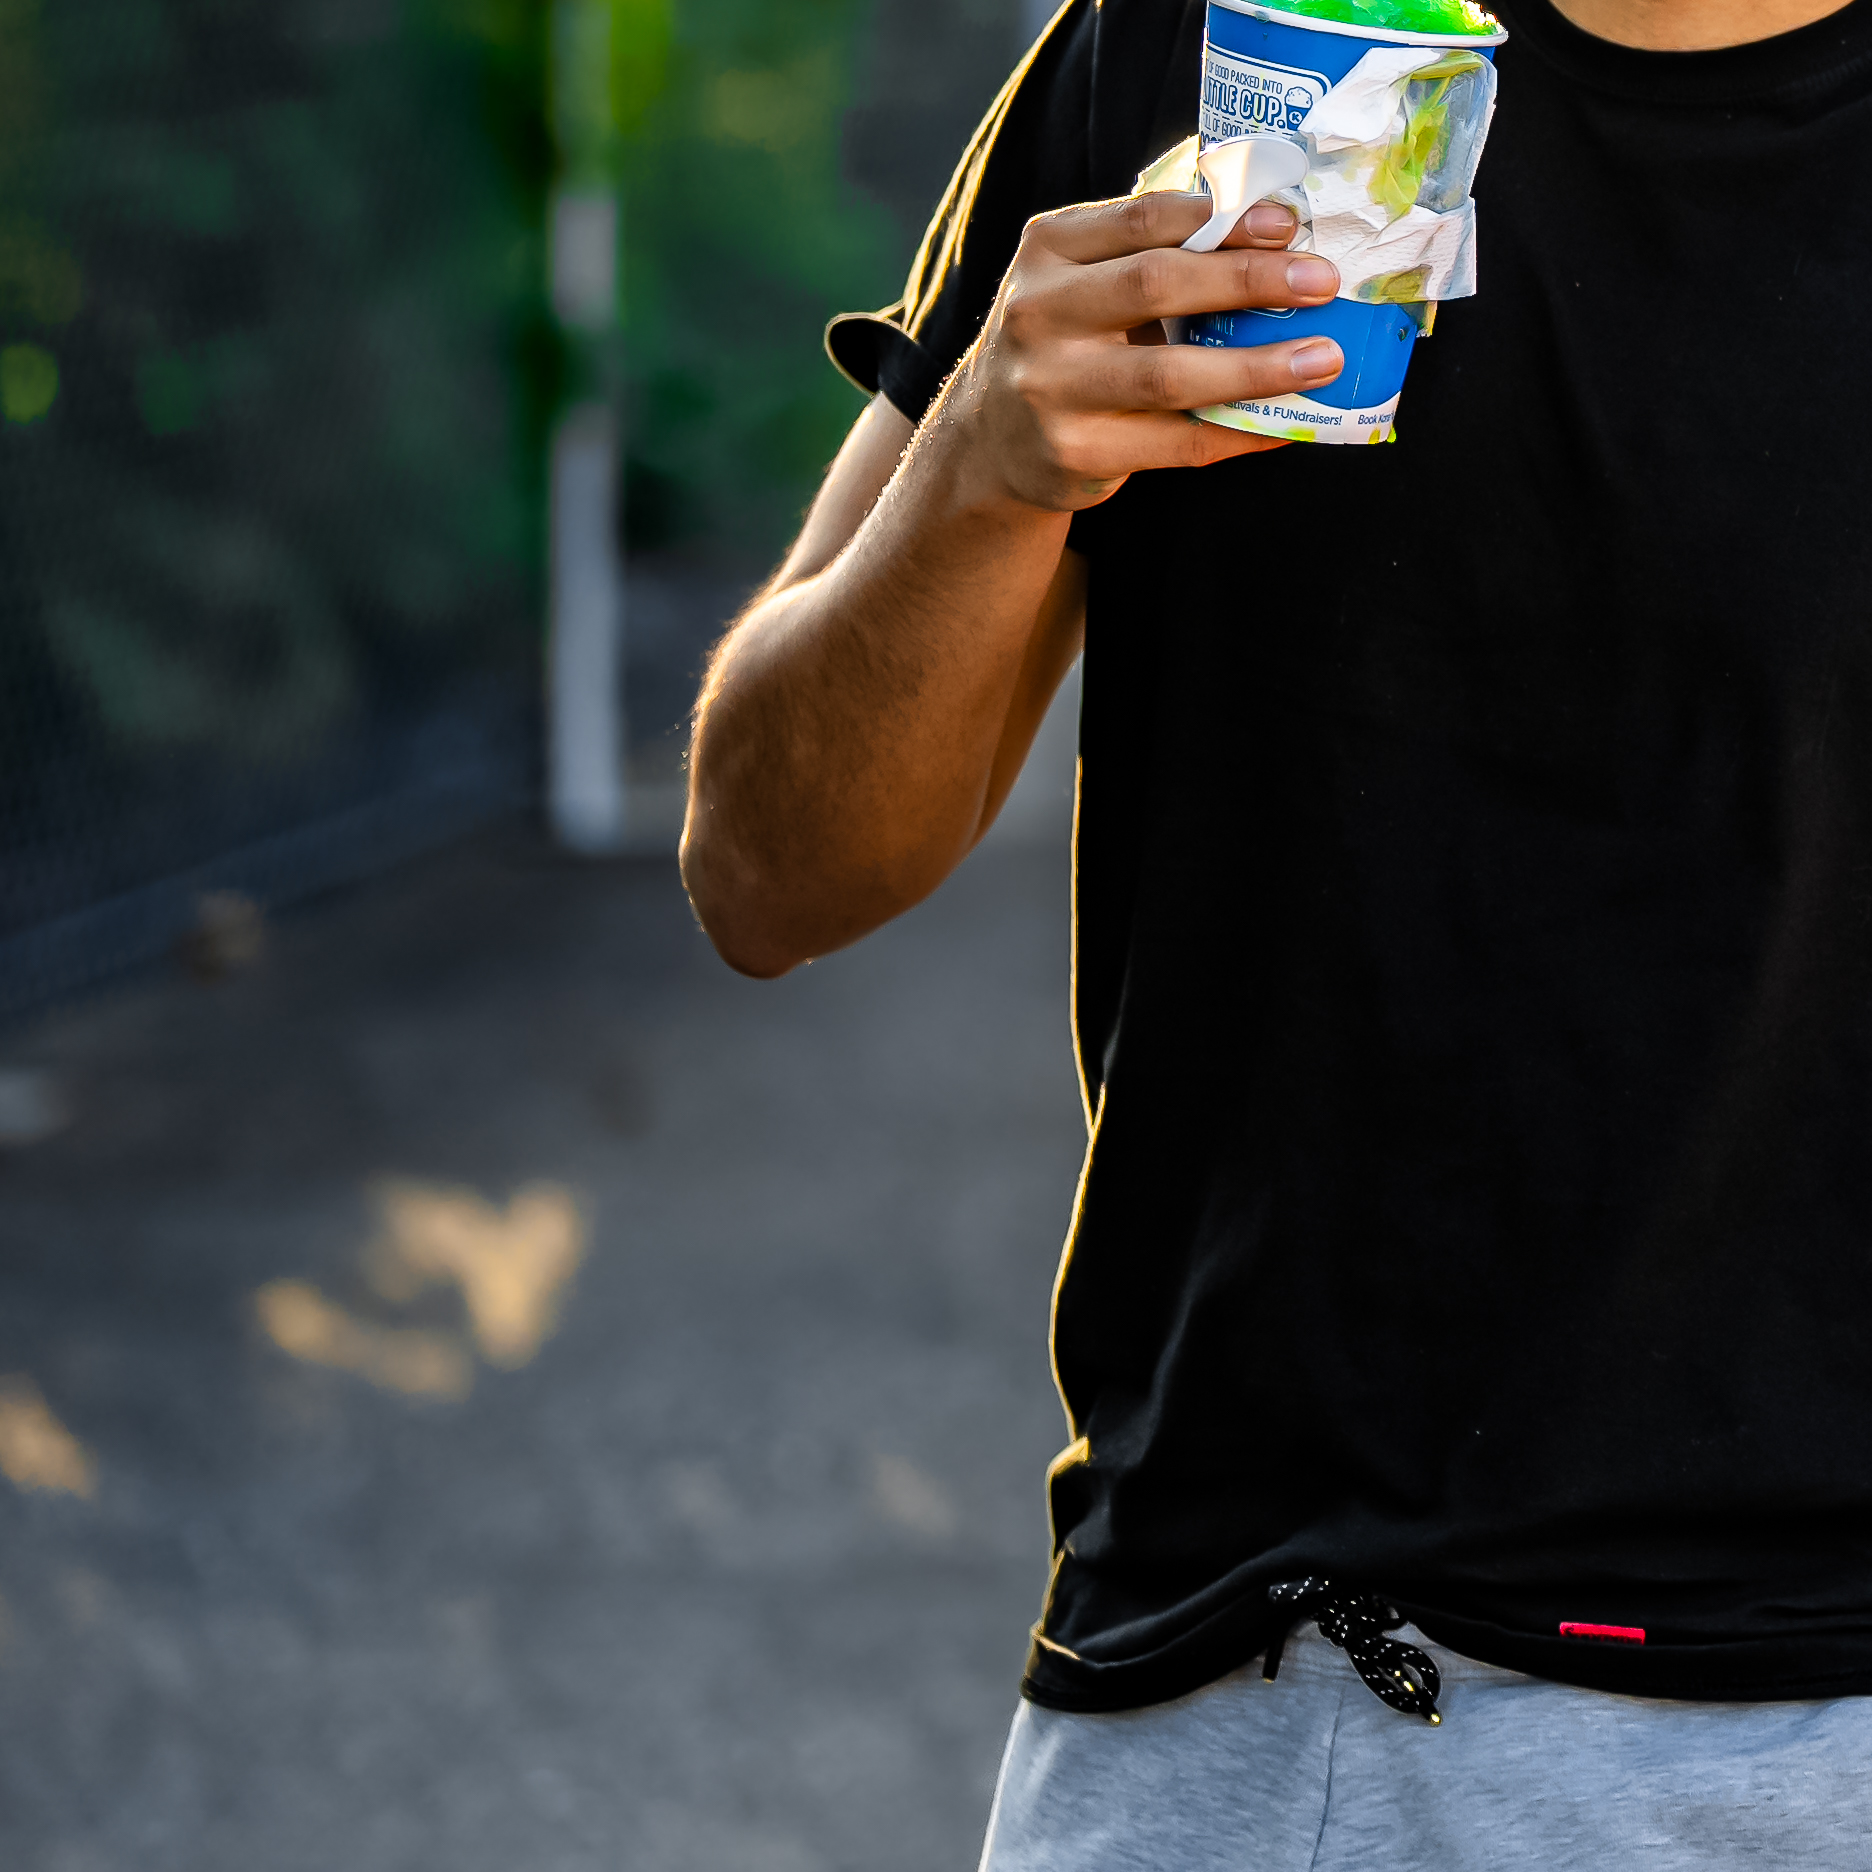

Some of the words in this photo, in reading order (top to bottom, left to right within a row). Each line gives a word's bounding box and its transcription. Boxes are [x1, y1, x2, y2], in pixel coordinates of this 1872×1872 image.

[1231, 70, 1260, 89] PACKED
[1262, 79, 1283, 95] INTO
[1240, 88, 1286, 129] CUP.
[1262, 404, 1271, 416] &
[1274, 406, 1342, 426] FUNdraisers!
[1358, 414, 1377, 425] Book
